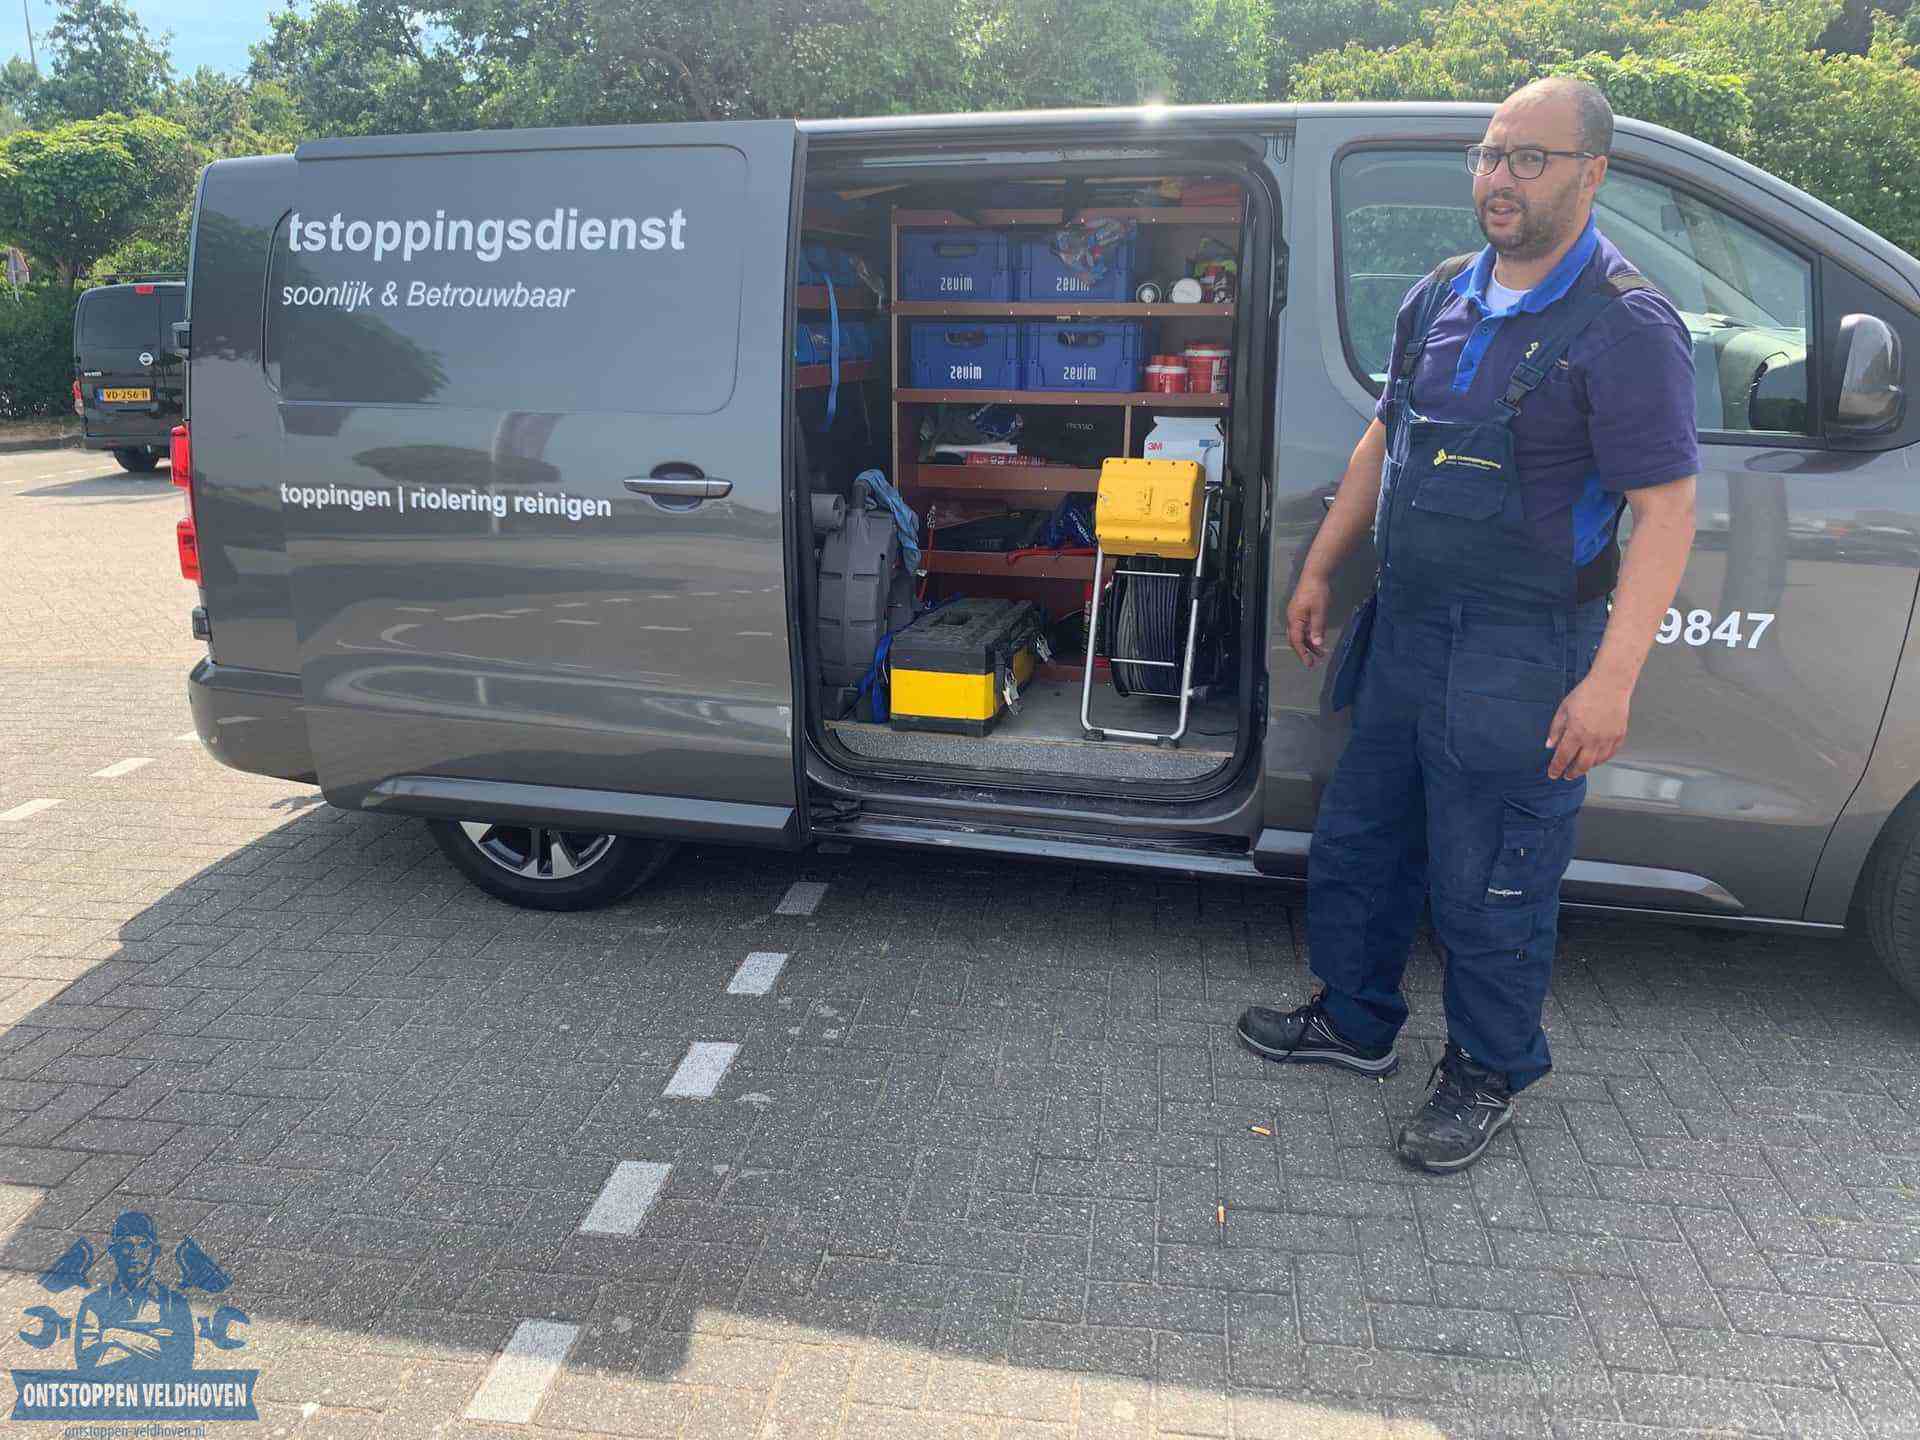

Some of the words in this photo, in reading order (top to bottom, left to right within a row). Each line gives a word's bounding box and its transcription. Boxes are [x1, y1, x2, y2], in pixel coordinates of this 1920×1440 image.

[289, 208, 687, 262] tstoppingsdienst
[282, 280, 374, 313] soonlijk
[381, 280, 399, 307] &
[406, 281, 576, 309] Betrouwbaar
[280, 482, 392, 512] toppingen
[410, 486, 507, 518] riolering
[514, 491, 612, 521] reinigen
[1655, 607, 1776, 649] 9847
